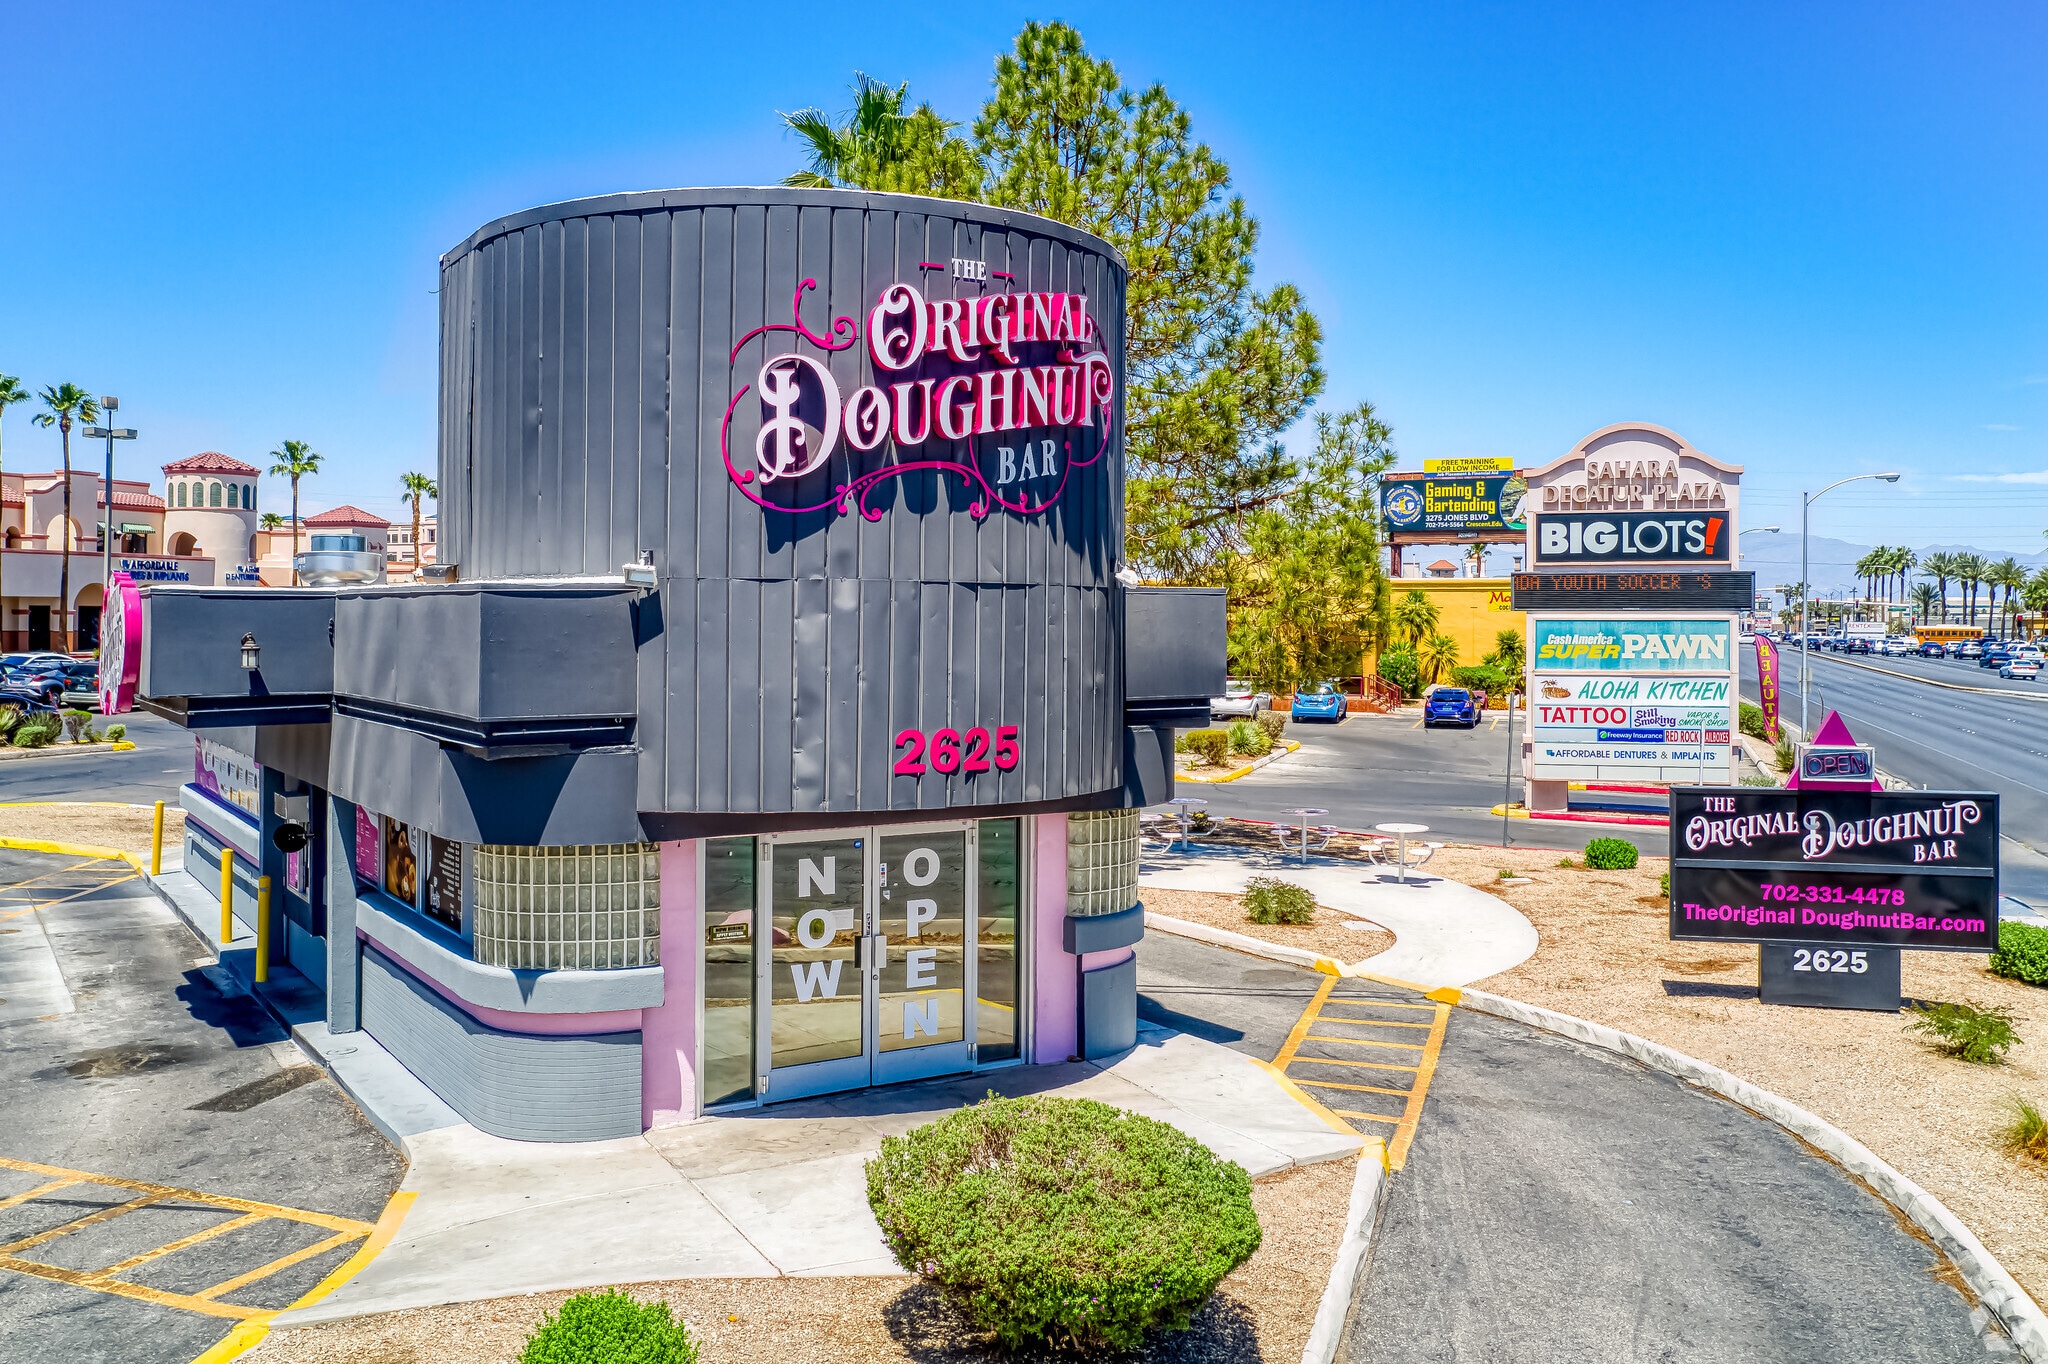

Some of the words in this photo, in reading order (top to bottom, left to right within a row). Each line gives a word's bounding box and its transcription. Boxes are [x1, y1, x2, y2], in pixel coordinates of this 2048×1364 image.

[952, 257, 987, 281] THE
[867, 283, 1093, 371] ORIGINAL
[755, 350, 1114, 484] DOUGHNUT
[997, 440, 1058, 484] BAR
[1587, 460, 1679, 480] SAHARA
[1425, 482, 1472, 499] Gaming
[1476, 481, 1485, 497] &
[1543, 485, 1644, 504] DECATUR
[1652, 483, 1726, 501] PLAZA
[1425, 497, 1496, 514] Bartending
[1552, 575, 1607, 590] YOUTH
[1617, 575, 1681, 590] SOCCER
[1538, 644, 1621, 659] SUPER
[1621, 634, 1728, 659] PAWN
[1577, 680, 1639, 700] ALOHA
[1646, 681, 1729, 700] KITCHEN
[1539, 707, 1627, 724] TATTOO
[1634, 715, 1677, 727] Smoking
[1636, 708, 1658, 719] Still
[1686, 711, 1712, 719] VAPOR
[1705, 719, 1729, 727] SHOP
[1607, 731, 1632, 740] Freeway
[1632, 731, 1663, 740] Insurance
[1666, 730, 1678, 743] RED
[1680, 731, 1699, 743] ROCK
[1705, 732, 1729, 743] AILBOXES
[893, 725, 1020, 776] 2625
[1555, 749, 1610, 759] AFFORDABLE
[1614, 750, 1657, 760] DENTURES
[1661, 751, 1668, 759] &
[1806, 754, 1867, 777] OPEN
[1703, 796, 1736, 812] THE
[1685, 811, 1800, 851] ORIGINAL
[1802, 800, 1982, 860] DOUGHNUT
[1914, 841, 1958, 863] BAR
[1760, 883, 1905, 905] 702-331-4478
[1683, 903, 1795, 924] TheOriginal
[1801, 911, 1986, 932] DoughnutBar.com
[790, 855, 844, 1003] NOW
[903, 847, 941, 1040] OPEN
[1793, 949, 1869, 974] 2625
